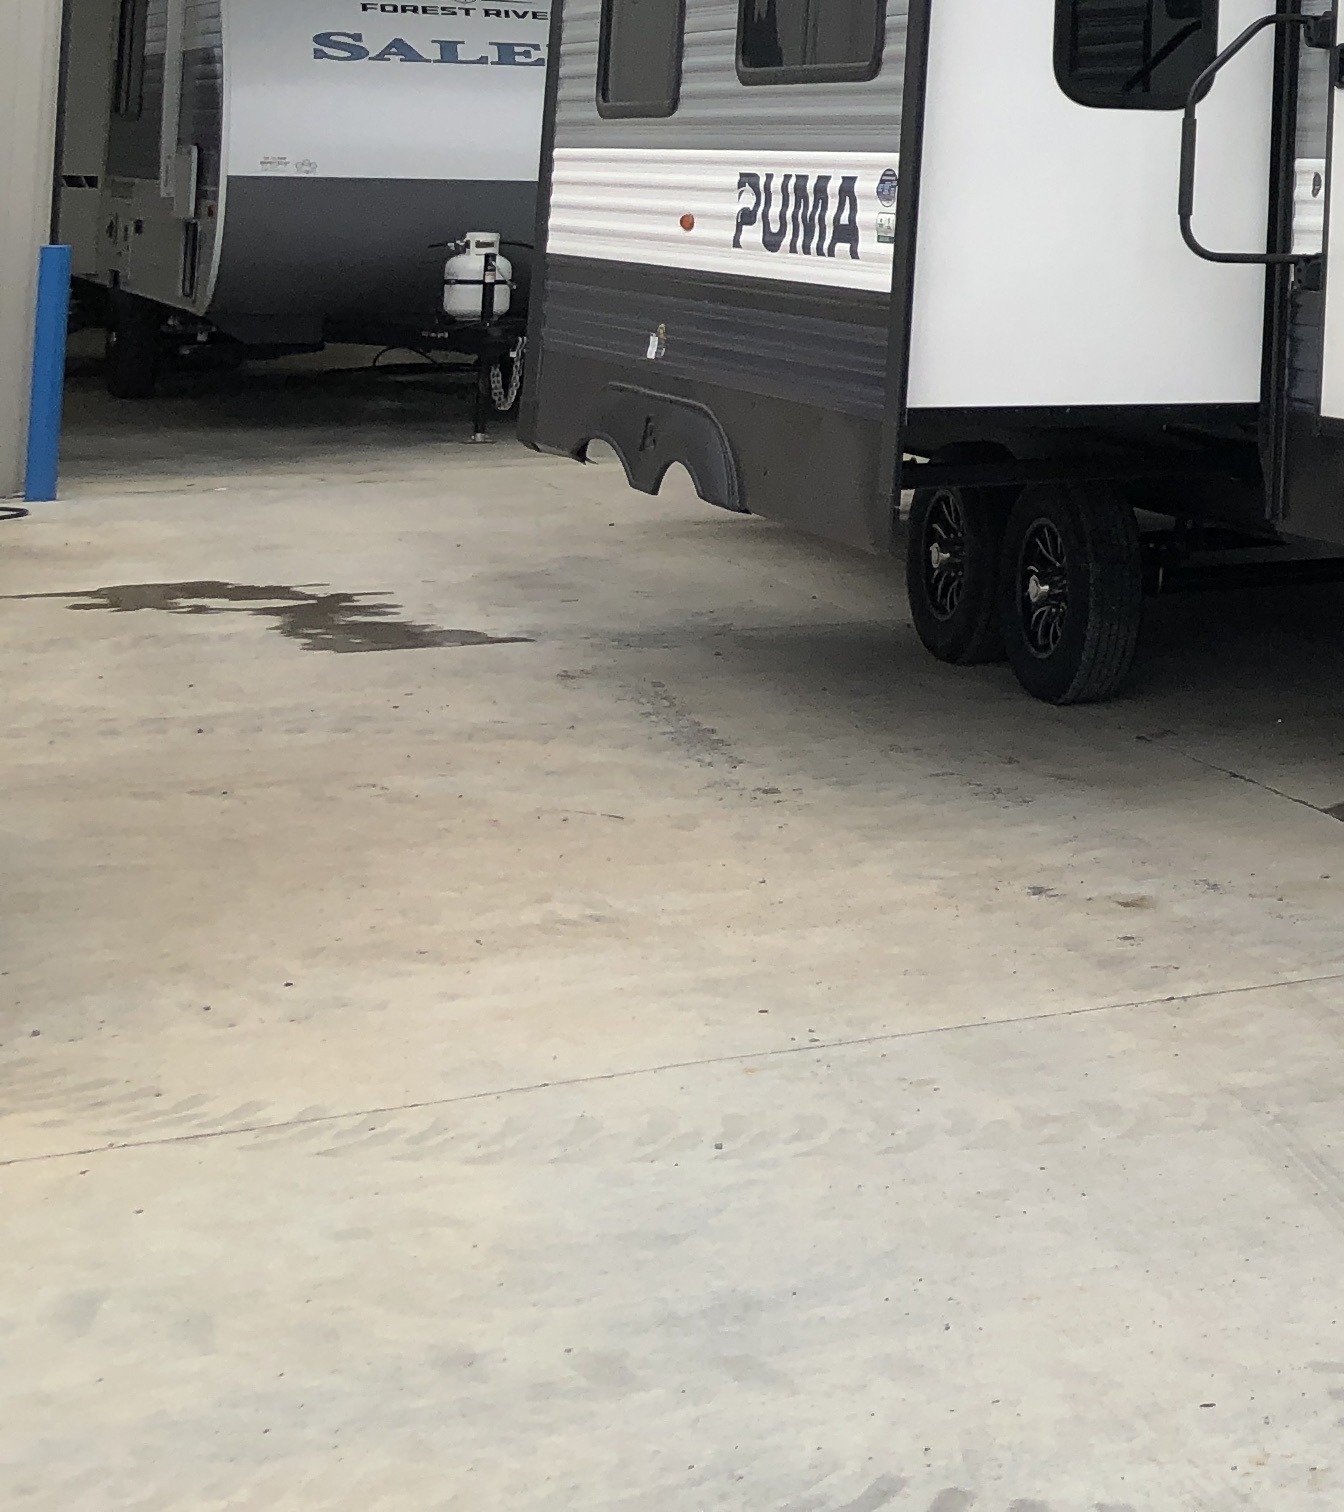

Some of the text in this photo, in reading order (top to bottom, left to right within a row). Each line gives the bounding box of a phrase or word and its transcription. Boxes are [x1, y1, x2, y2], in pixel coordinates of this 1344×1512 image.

[360, 2, 549, 20] FOREST RIVE
[312, 31, 549, 66] SALE
[732, 172, 860, 259] PUMA
